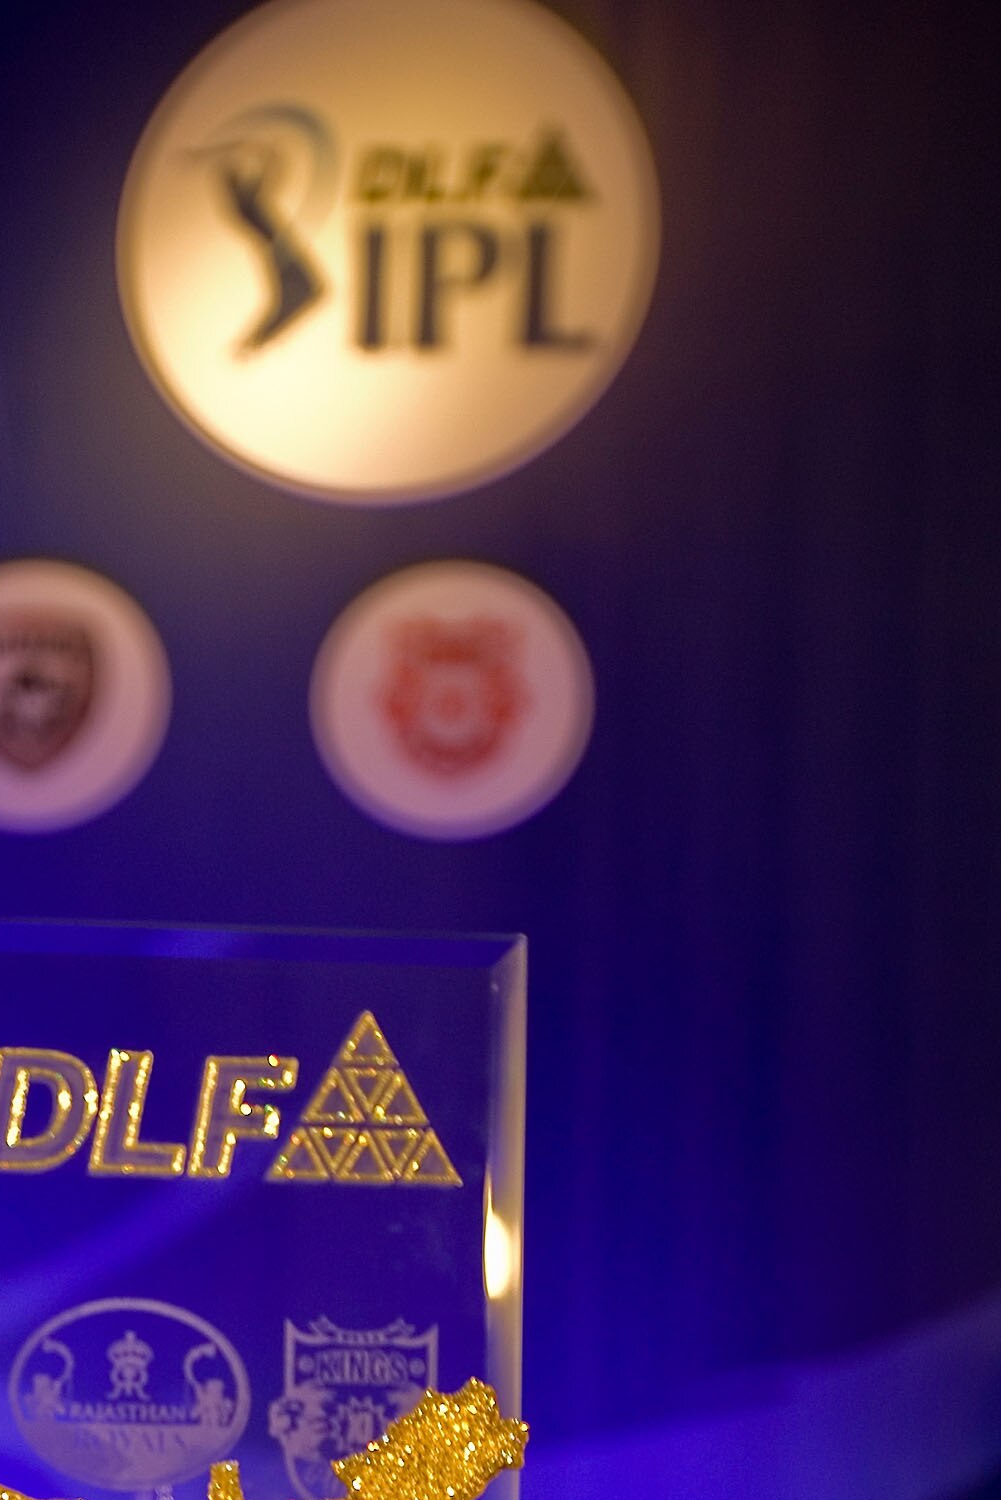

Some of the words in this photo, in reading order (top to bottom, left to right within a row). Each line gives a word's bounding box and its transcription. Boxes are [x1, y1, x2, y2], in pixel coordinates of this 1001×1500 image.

[356, 144, 506, 201] DLF
[353, 222, 594, 352] IPL
[316, 1349, 409, 1387] KINGS
[68, 1402, 187, 1423] RAJASTHAN
